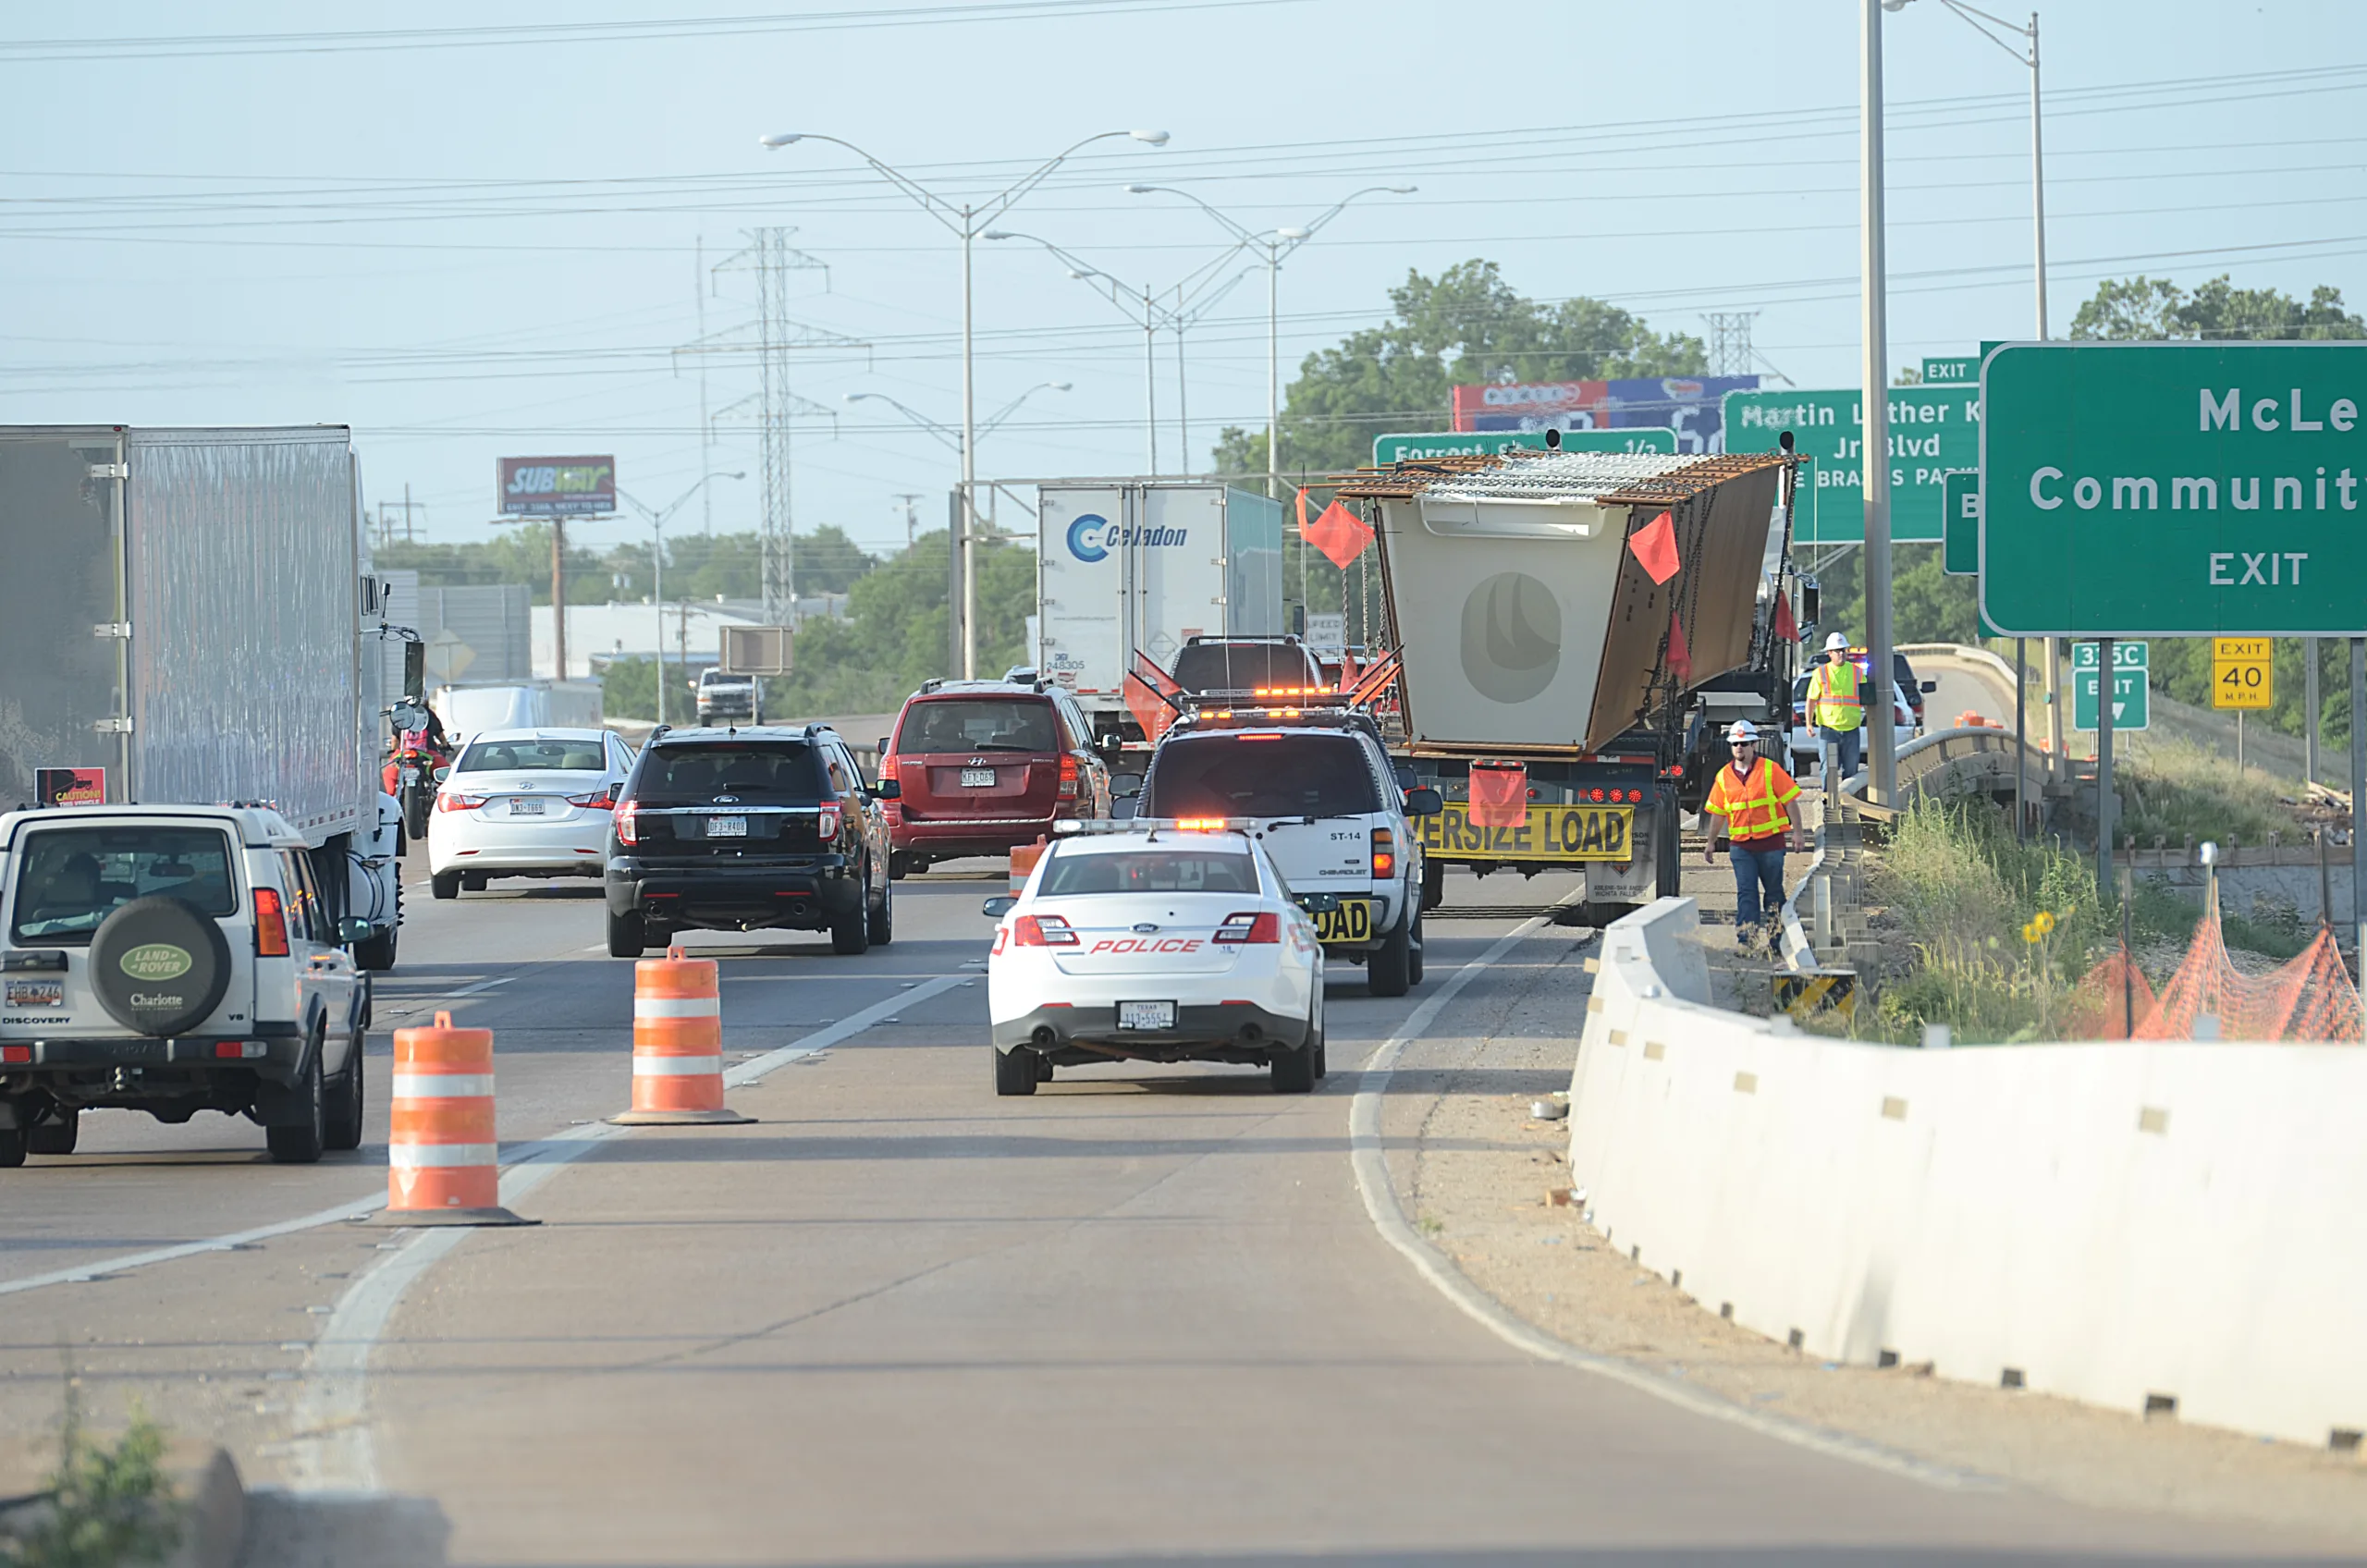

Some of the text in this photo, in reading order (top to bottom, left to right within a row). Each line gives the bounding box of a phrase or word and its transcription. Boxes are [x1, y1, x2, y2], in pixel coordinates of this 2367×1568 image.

[1928, 363, 1967, 378] EXIT
[1741, 403, 1834, 428] Martin
[1852, 400, 1949, 424] Lther
[2200, 388, 2359, 432] McLe
[507, 465, 610, 494] SUBWAY
[2030, 466, 2367, 509] Communit
[1106, 525, 1187, 547] Celadon
[2210, 553, 2309, 585] EXIT
[2221, 643, 2263, 655] EXIT
[1046, 660, 1085, 669] 248305
[2222, 667, 2263, 687] 40
[2088, 679, 2133, 695] EIT
[55, 790, 101, 802] CAUTION!
[1331, 832, 1361, 840] ST-14
[1545, 812, 1625, 852] LOAD
[1090, 938, 1205, 955] POLICE
[135, 950, 169, 962] LAND
[138, 962, 182, 973] ROVER
[130, 992, 183, 1006] Charlotte
